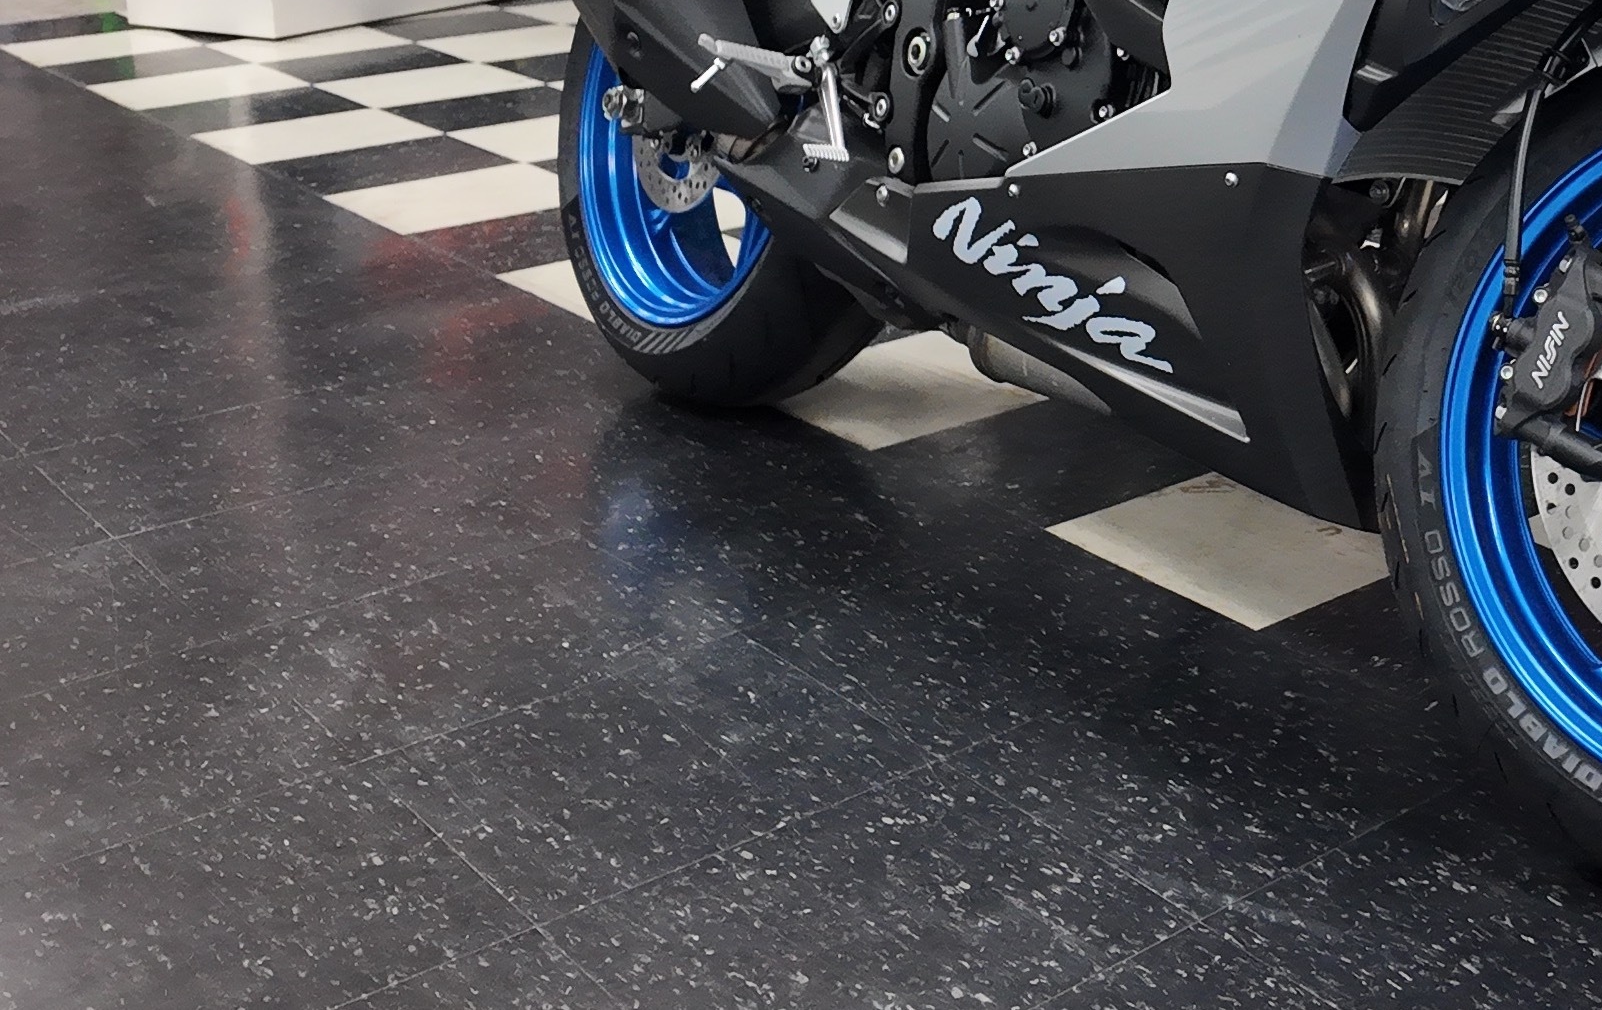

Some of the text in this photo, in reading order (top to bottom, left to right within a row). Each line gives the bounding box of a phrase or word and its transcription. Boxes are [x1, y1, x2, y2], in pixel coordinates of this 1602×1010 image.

[931, 196, 1174, 374] Ninja
[1529, 310, 1571, 389] NISSIN
[1423, 529, 1486, 659] ROSSO
